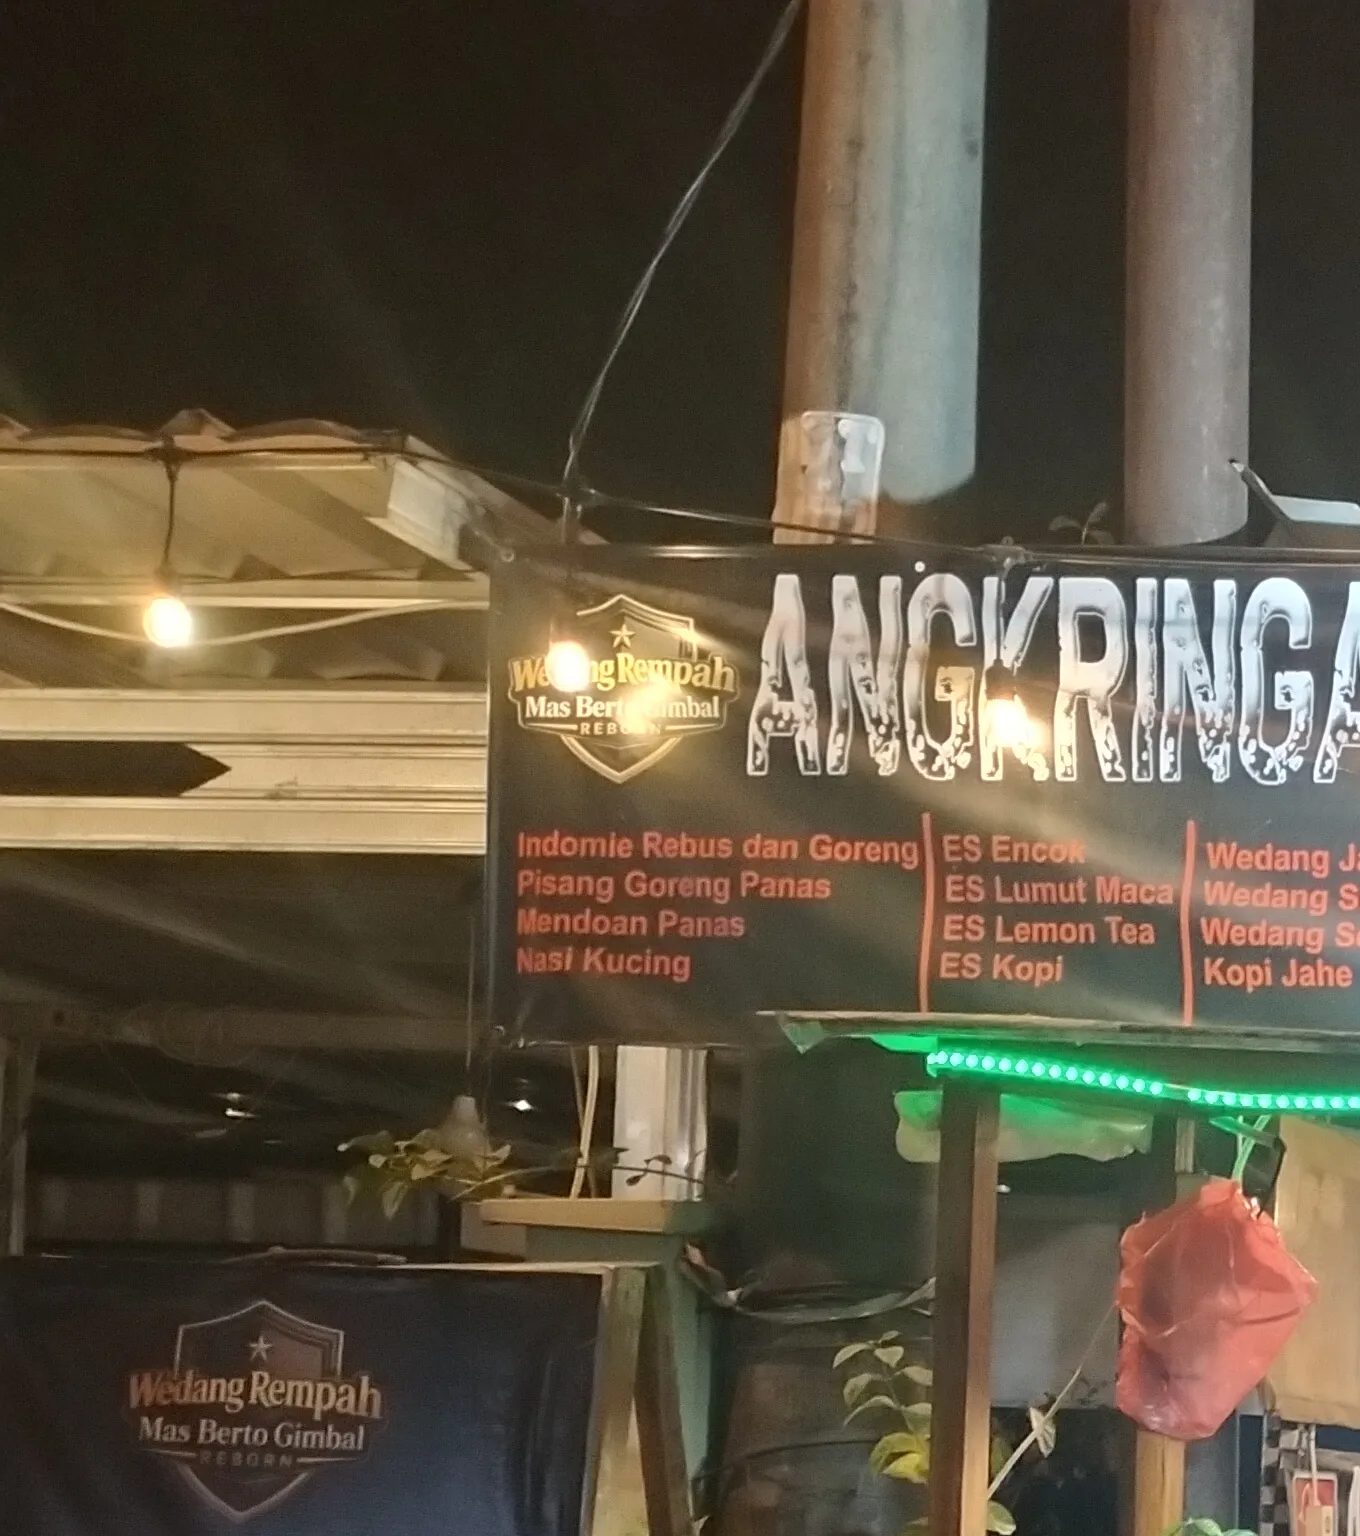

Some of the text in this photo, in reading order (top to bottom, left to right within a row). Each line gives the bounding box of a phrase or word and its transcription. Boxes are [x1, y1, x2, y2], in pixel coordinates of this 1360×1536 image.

[616, 652, 736, 692] Rempah
[525, 696, 571, 718] Mas
[517, 832, 918, 870] Indomie Rebus dan Goreng
[943, 834, 1086, 864] ES Encok
[1206, 842, 1330, 878] Wedang
[517, 869, 831, 904] Pisang Goreng Panas
[945, 875, 1174, 905] ES Lumut Maca
[1203, 880, 1328, 916] Wedang
[517, 907, 745, 938] Mendoan Panas
[943, 915, 1156, 945] ES Lemon Tea
[1200, 917, 1325, 955] Wedang
[517, 947, 691, 982] Nasi Kucing
[940, 952, 1063, 988] ES Kopi
[1203, 957, 1353, 993] Kopi Jahe
[129, 1369, 382, 1421] Wedang Rempah
[139, 1415, 364, 1450] Mas Berto Gimbal
